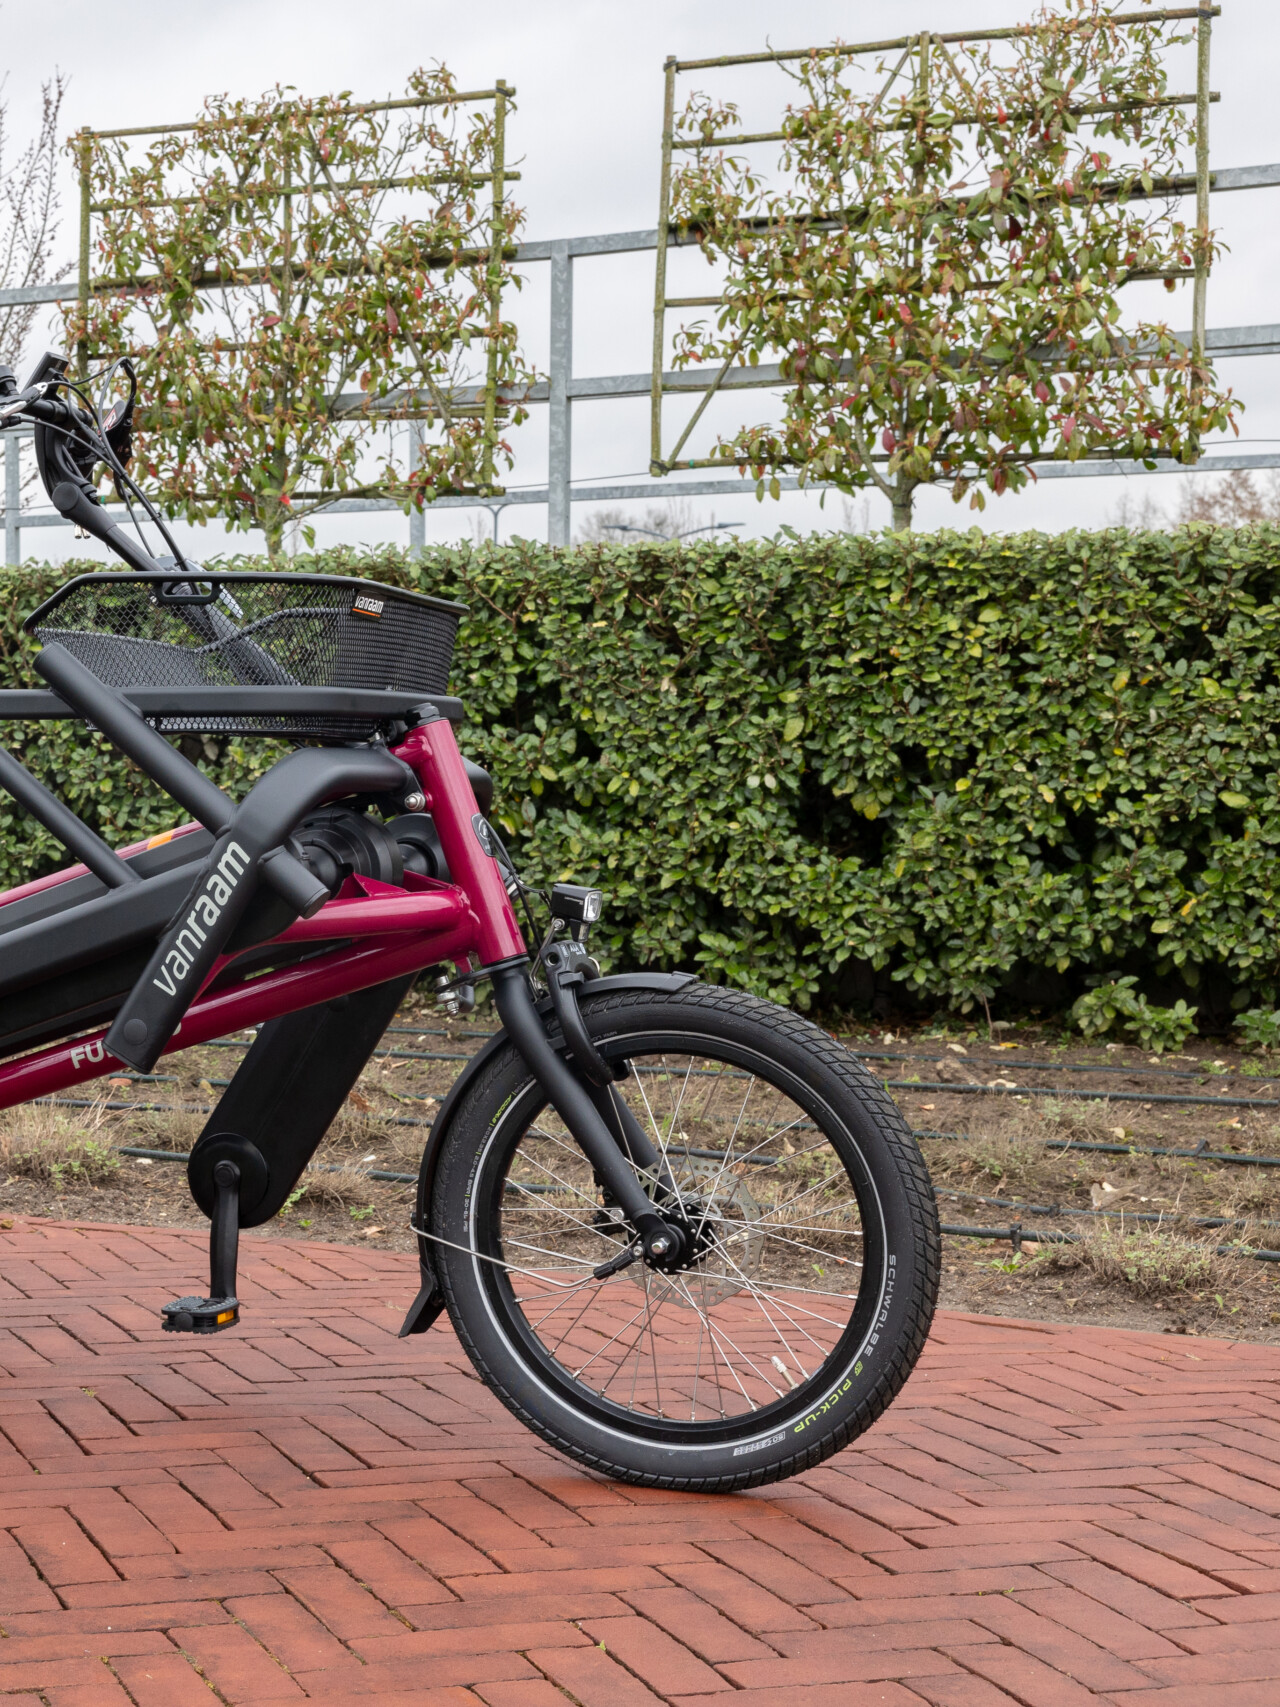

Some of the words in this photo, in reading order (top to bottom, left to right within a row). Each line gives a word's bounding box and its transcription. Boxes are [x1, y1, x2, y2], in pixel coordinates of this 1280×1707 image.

[355, 596, 384, 613] vanraam
[153, 841, 251, 996] vanraam
[864, 1254, 896, 1357] SCHWALBE
[794, 1379, 852, 1433] PICK-UP
